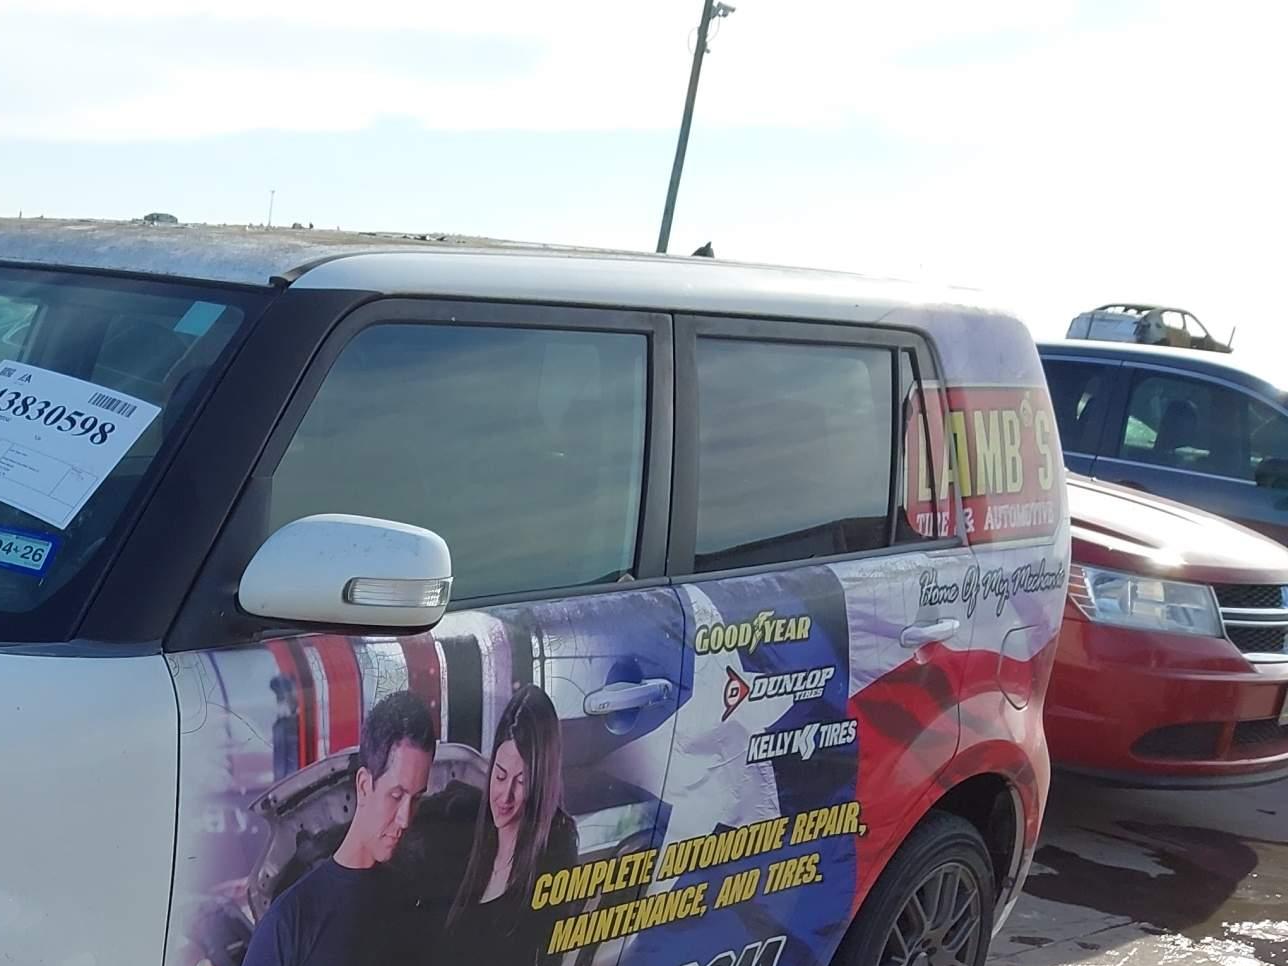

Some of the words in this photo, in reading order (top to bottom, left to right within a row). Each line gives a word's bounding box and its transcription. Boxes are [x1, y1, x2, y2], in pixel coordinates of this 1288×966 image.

[983, 500, 1055, 532] AUTOMOTIVE
[20, 545, 45, 563] 26
[918, 567, 961, 608] Home
[961, 564, 981, 619] Of
[982, 567, 1010, 618] My
[749, 666, 835, 701] DUNLOP
[794, 687, 824, 701] TIRES
[748, 731, 793, 762] KELLY
[819, 720, 857, 748] TIRES
[530, 847, 658, 912] COMPLETE
[657, 816, 789, 880] AUTOMOTIVE
[789, 801, 867, 845] REPAIR,
[546, 883, 710, 956] MAINTENANCE,
[713, 868, 762, 910] AND
[763, 853, 825, 896] TIRES.
